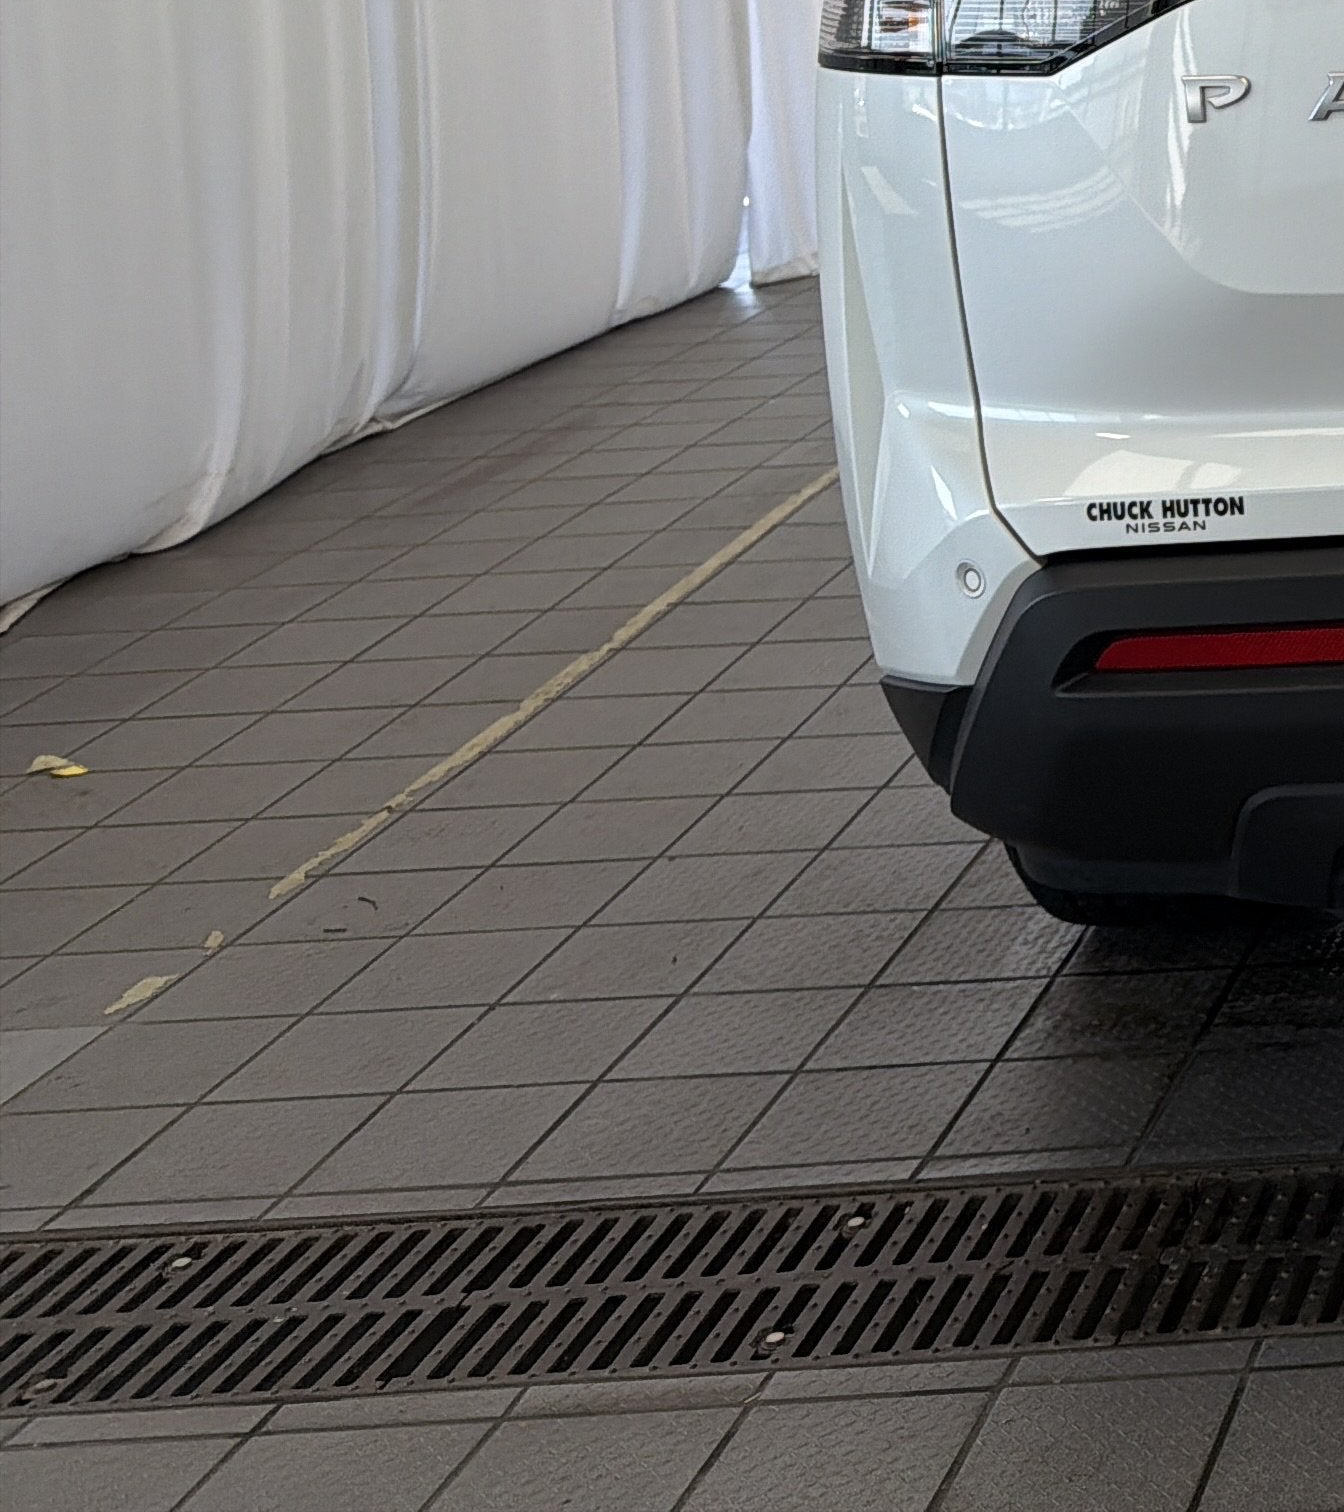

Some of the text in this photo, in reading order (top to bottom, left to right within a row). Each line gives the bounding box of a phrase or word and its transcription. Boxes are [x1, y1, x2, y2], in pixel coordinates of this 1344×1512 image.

[1087, 496, 1245, 521] CHUCK HUTTON
[1126, 520, 1206, 534] NISSAN
